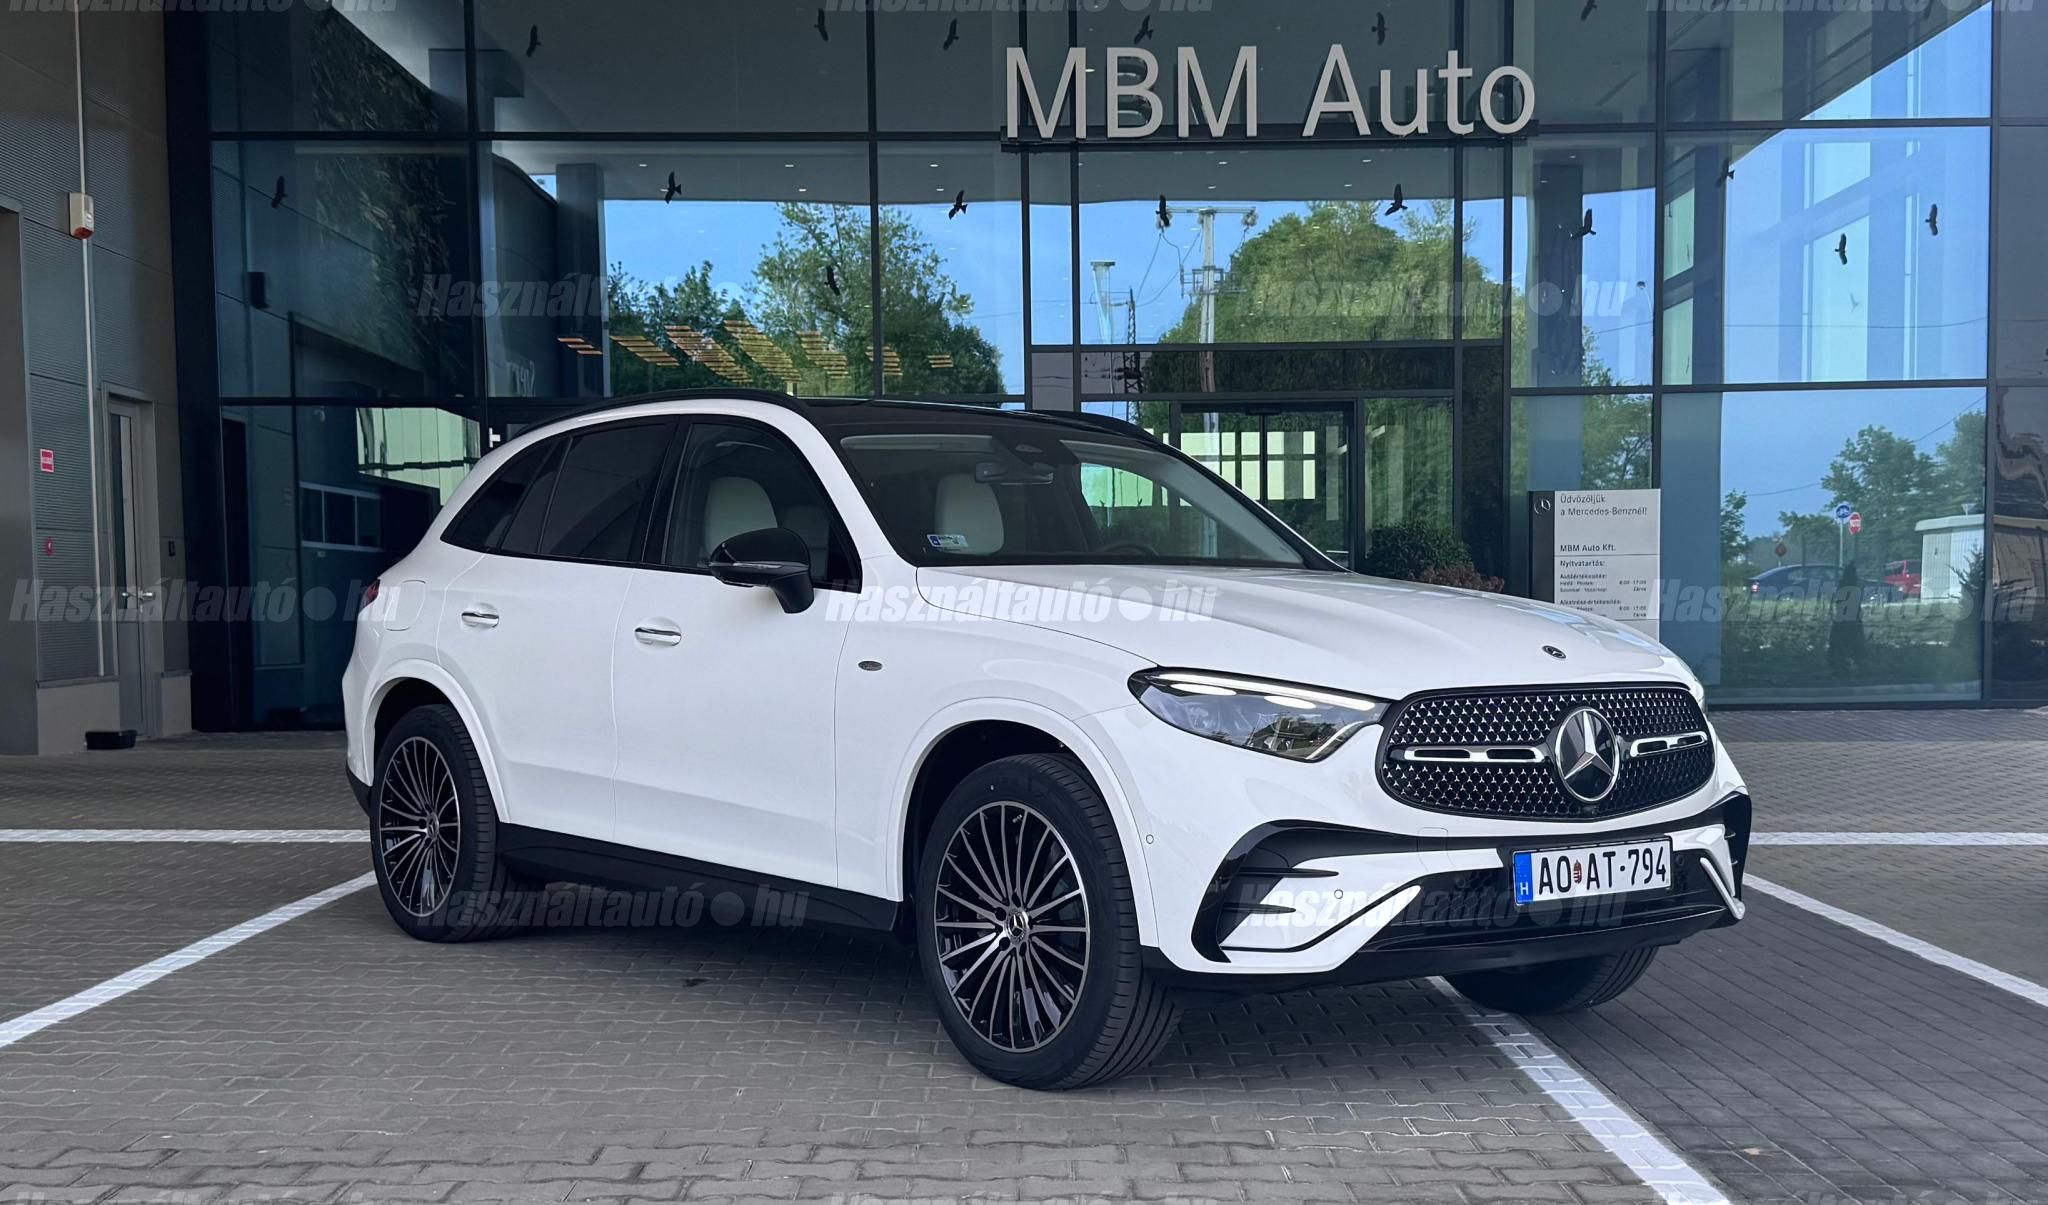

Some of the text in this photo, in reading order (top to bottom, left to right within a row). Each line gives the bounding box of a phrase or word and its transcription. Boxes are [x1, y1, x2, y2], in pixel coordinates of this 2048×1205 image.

[1005, 43, 1536, 140] MBM Auto
[1560, 493, 1606, 505] Üdvözöljük
[1560, 543, 1617, 552] MBM Auto Kft.
[1538, 855, 1572, 895] AO
[1519, 881, 1529, 896] H
